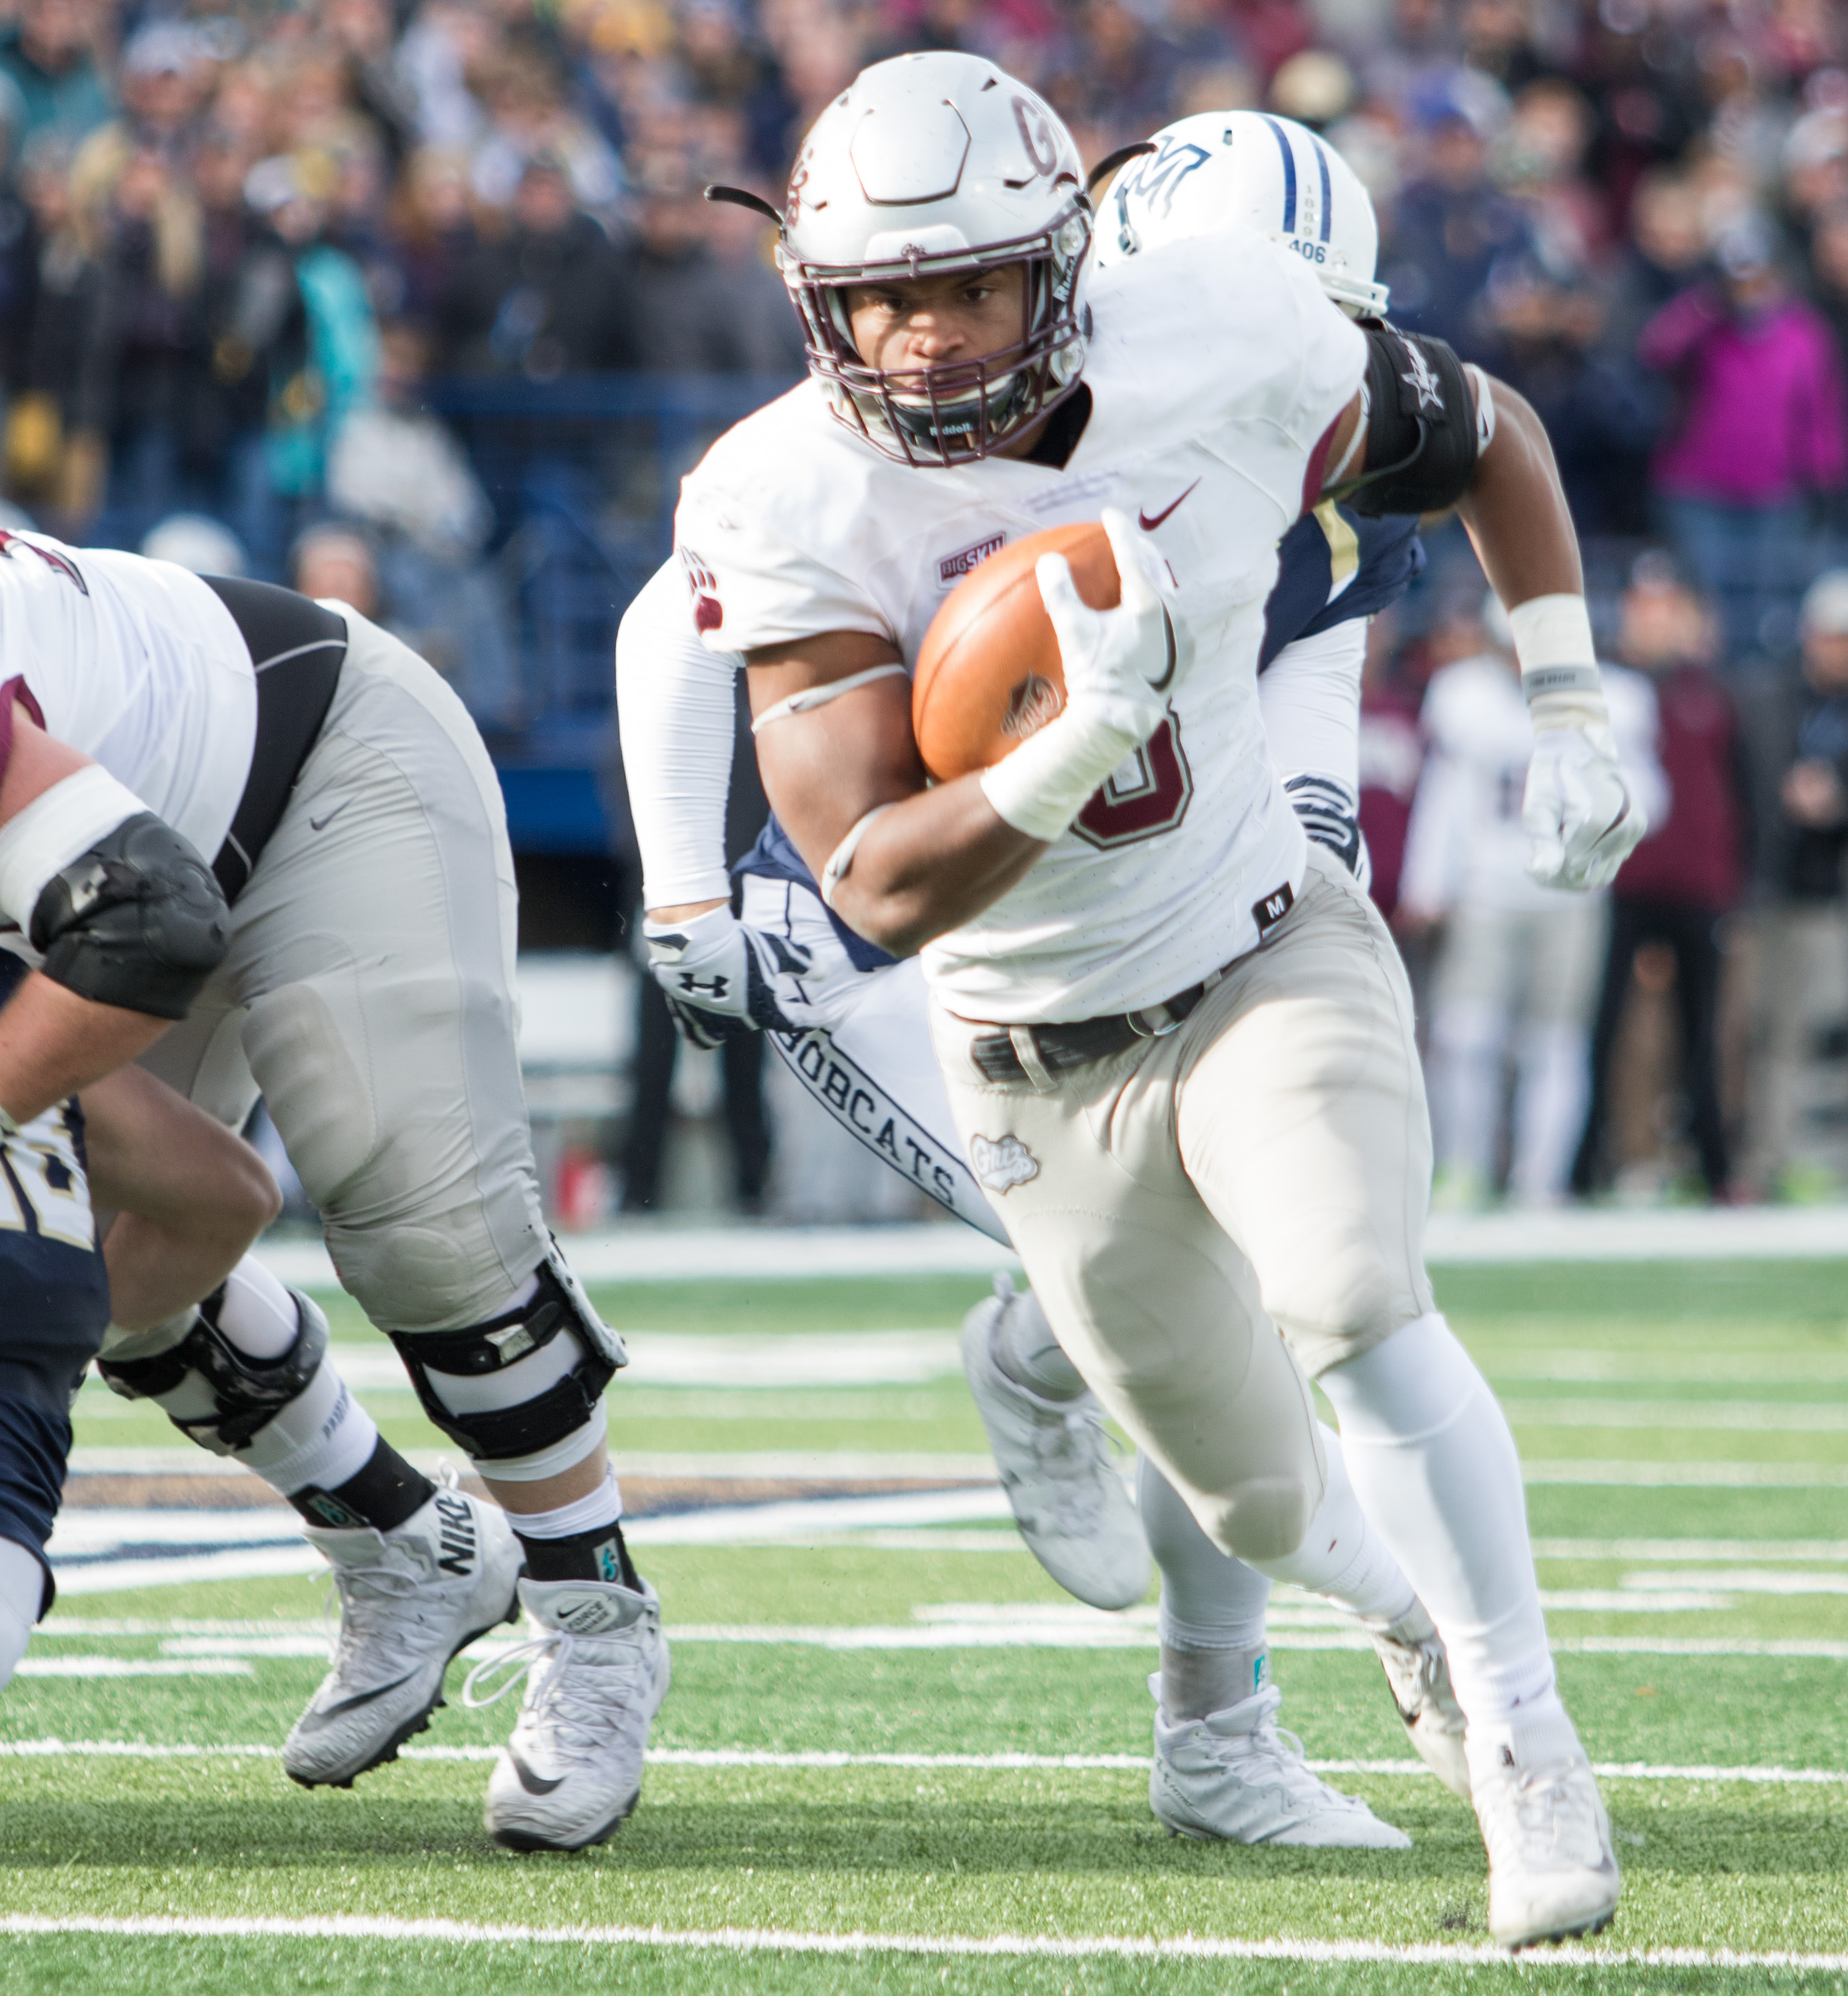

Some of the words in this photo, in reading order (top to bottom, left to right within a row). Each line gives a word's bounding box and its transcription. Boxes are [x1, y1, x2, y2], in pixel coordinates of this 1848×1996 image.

[1289, 239, 1326, 263] 406
[929, 422, 972, 437] Rddell
[1266, 895, 1285, 919] M
[436, 1496, 475, 1577] NIKE
